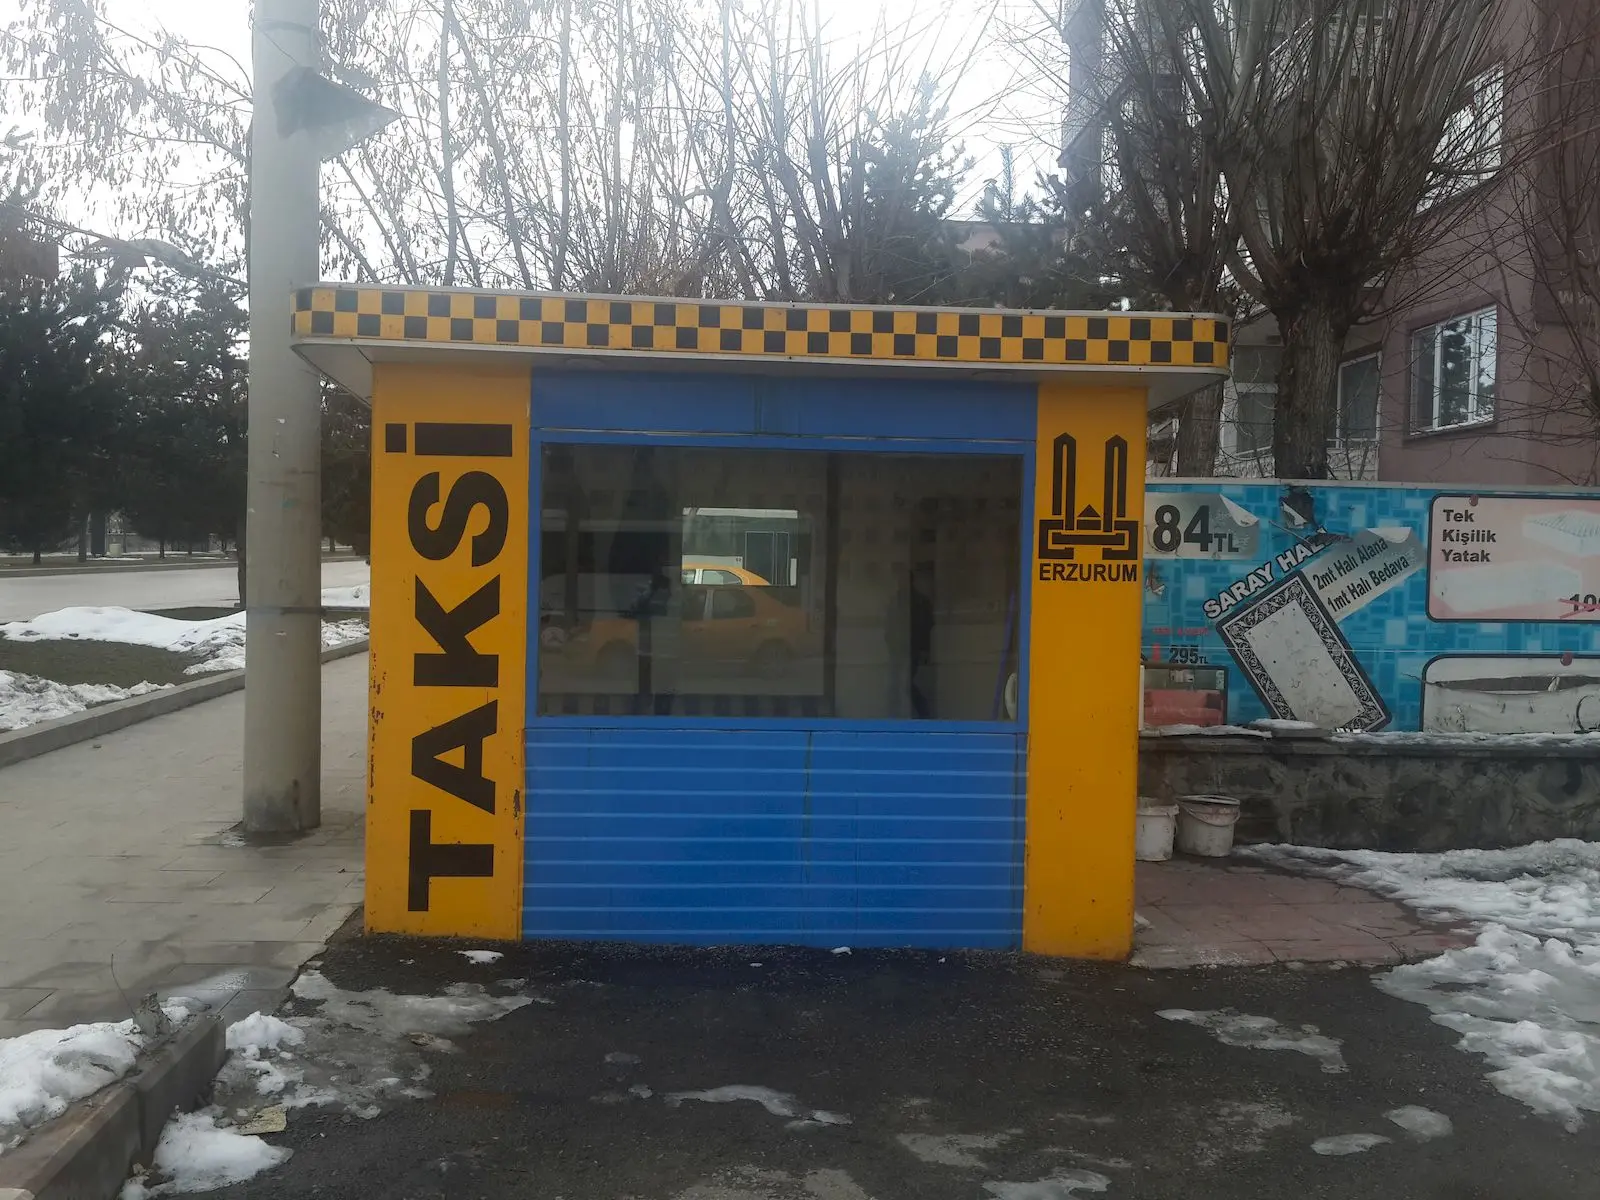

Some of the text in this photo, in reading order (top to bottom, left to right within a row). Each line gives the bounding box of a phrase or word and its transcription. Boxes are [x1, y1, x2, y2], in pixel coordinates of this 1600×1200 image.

[1443, 509, 1474, 522] Tek
[1442, 529, 1496, 545] Kişilik
[1039, 562, 1138, 582] ERZURUM
[1312, 538, 1389, 591] 2mt Halı Alana
[1442, 549, 1491, 562] Yatak
[1203, 561, 1275, 618] SARAY
[1327, 556, 1410, 612] 1mt Halı Bedava
[385, 422, 513, 912] TAKSİ
